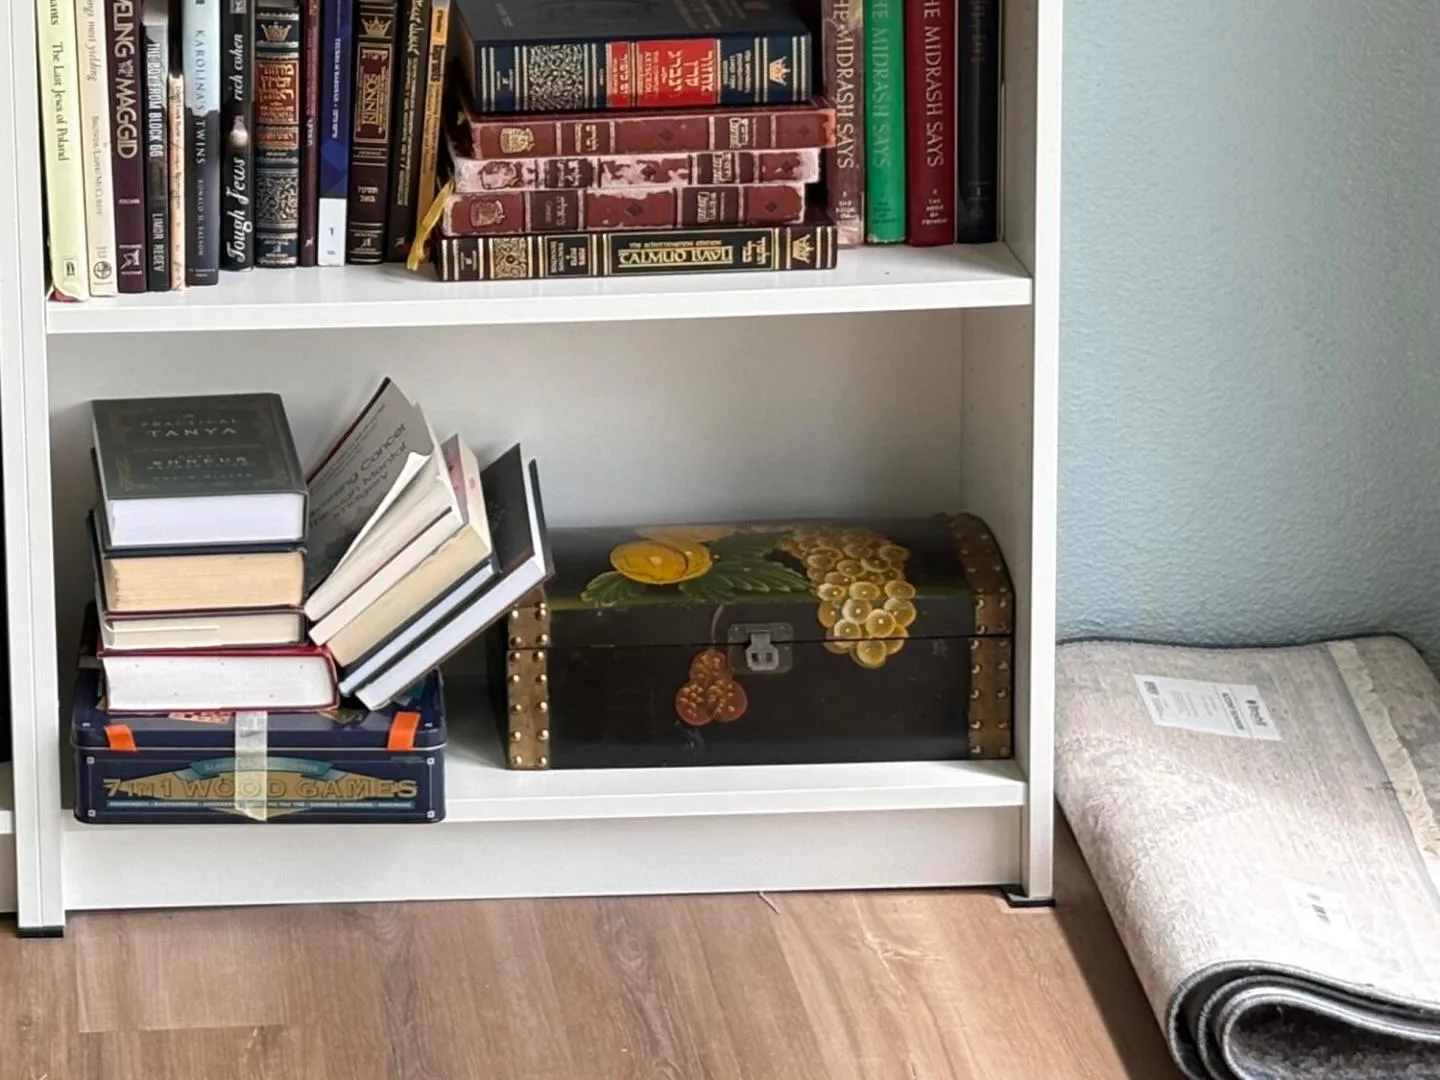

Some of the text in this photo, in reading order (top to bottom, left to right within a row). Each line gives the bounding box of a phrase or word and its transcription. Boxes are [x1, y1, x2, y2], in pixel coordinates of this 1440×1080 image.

[232, 34, 243, 101] rich cohen
[925, 26, 943, 117] MIDRASH
[115, 77, 138, 159] MAGGID
[926, 122, 944, 168] SAYS
[226, 158, 253, 263] Tough Jews
[146, 426, 238, 438] TANYA
[294, 779, 418, 797] GAMES
